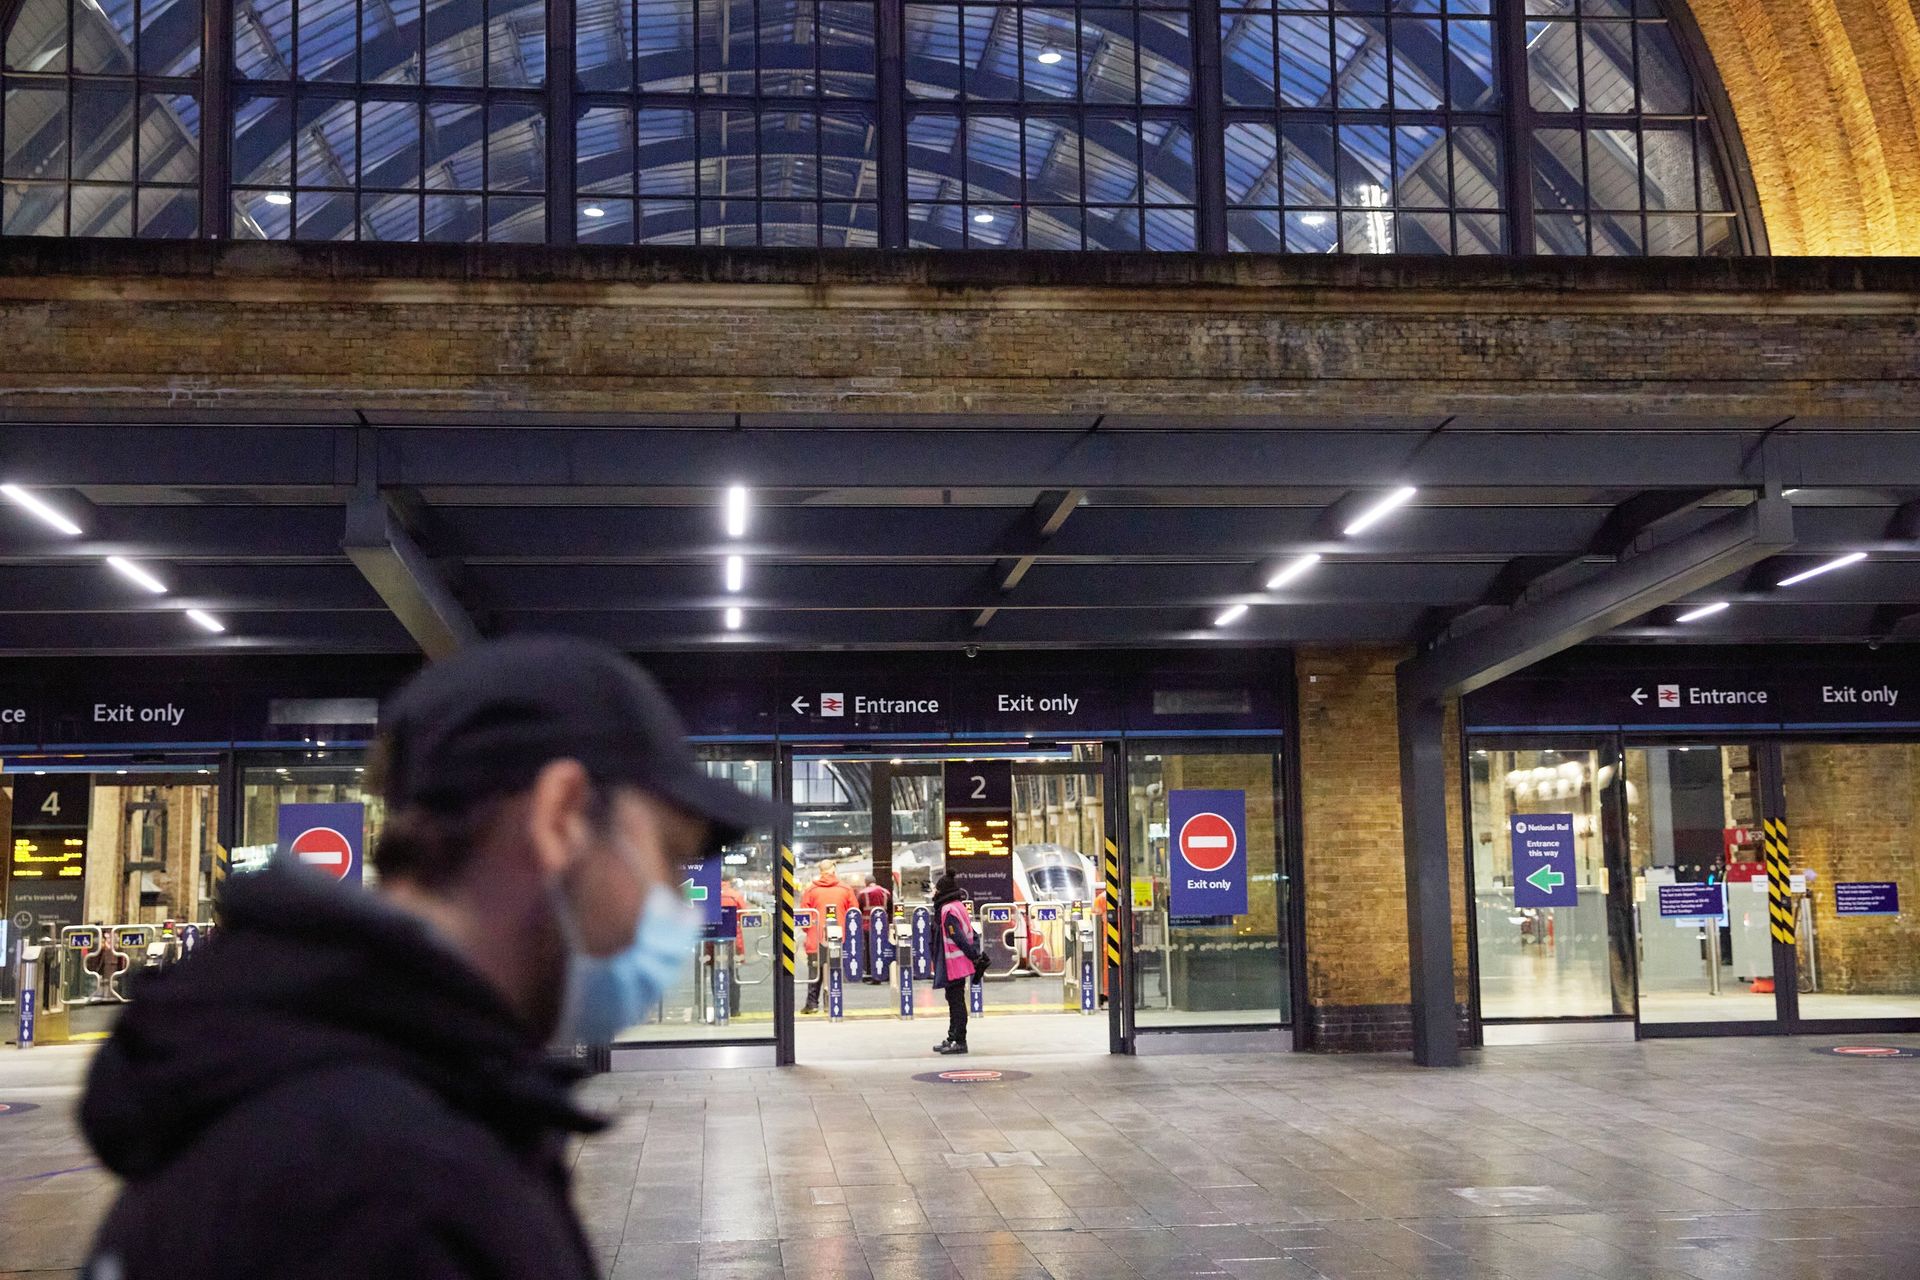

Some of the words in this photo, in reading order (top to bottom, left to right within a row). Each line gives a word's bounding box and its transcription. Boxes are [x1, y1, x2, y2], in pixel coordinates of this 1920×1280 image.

[855, 696, 939, 714] Entrance
[997, 694, 1035, 712] Exit
[1039, 693, 1079, 715] only
[1689, 687, 1768, 705] Entrance
[1822, 686, 1857, 704] Exit
[1861, 685, 1899, 707] only
[94, 703, 135, 723] Exit
[140, 702, 185, 726] only
[970, 775, 987, 799] 2
[40, 791, 61, 816] 4
[1557, 823, 1569, 831] Rail
[1187, 880, 1208, 890] Exit
[1208, 879, 1232, 891] only
[33, 893, 55, 902] travel
[56, 892, 78, 902] safely
